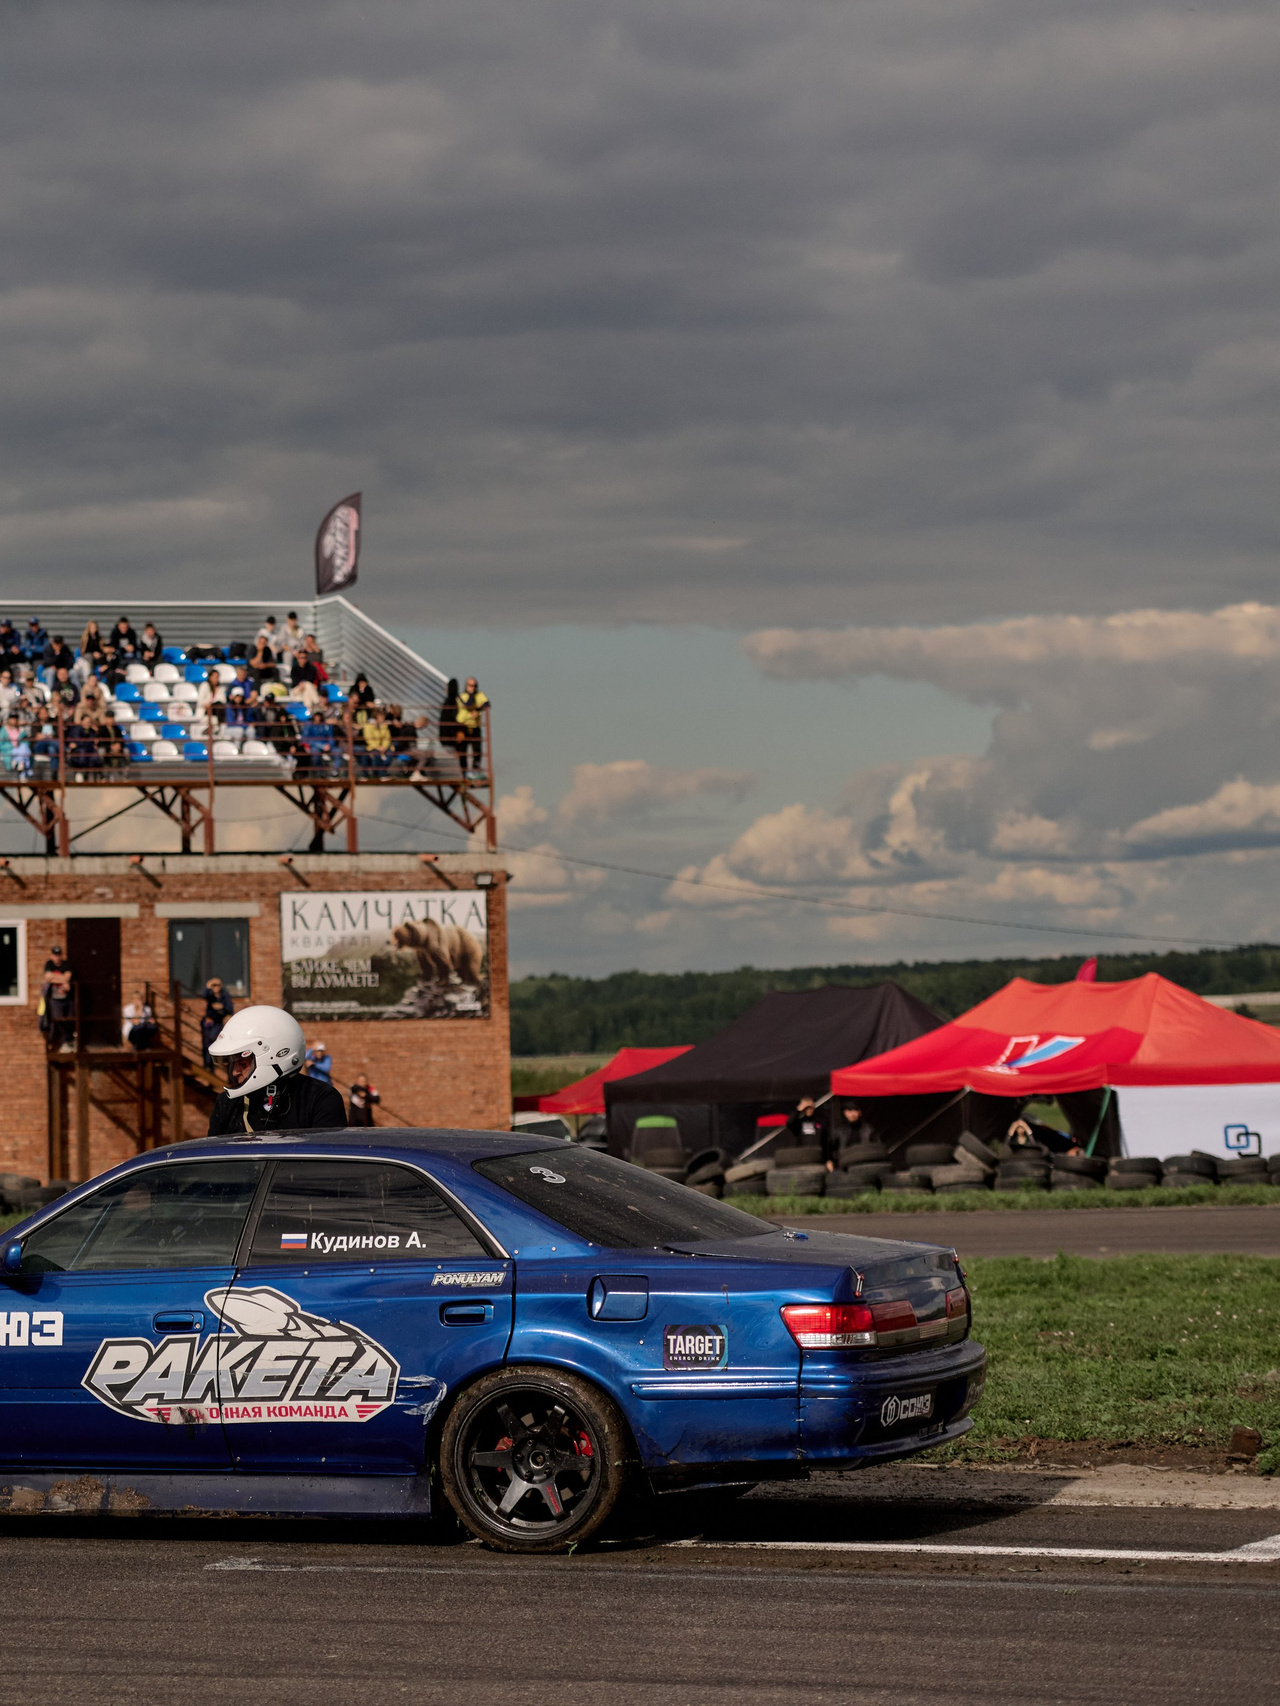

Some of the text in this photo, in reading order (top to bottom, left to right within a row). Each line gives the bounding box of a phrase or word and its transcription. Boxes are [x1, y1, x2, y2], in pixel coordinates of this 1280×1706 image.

[291, 899, 486, 931] КАМЧАТКА
[291, 935, 370, 948] КВАРТАЛ
[342, 960, 371, 974] ЧЕМ
[291, 973, 379, 988] ВЫ ДУМАЕТЕ!
[310, 1231, 427, 1253] Кудинов А.
[432, 1272, 505, 1285] PONULYAM
[667, 1335, 723, 1355] TARGET
[88, 1338, 394, 1402] РАКЕТА
[267, 1405, 348, 1419] КОМАНДА
[900, 1394, 931, 1419] СОЮЗ
